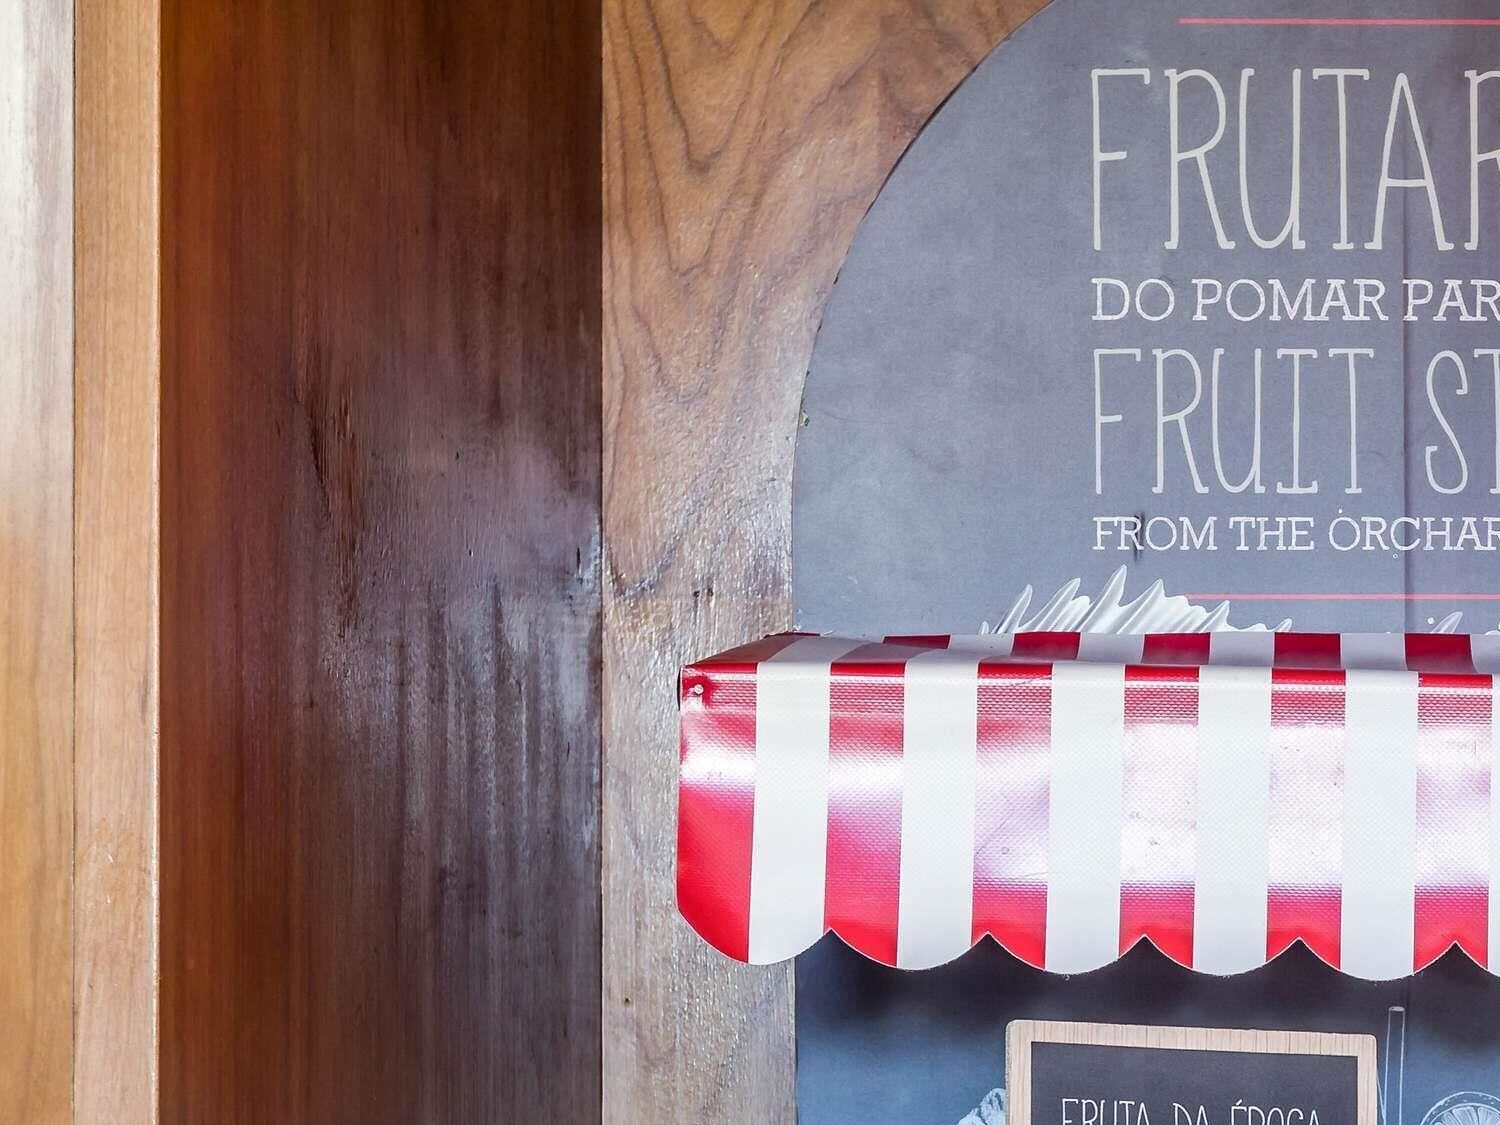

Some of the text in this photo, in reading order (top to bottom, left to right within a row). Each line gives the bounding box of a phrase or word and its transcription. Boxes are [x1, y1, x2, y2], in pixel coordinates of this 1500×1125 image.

[1092, 278, 1175, 321] DO
[1192, 278, 1388, 321] POMAR
[1094, 348, 1374, 494] FRUIT
[1092, 516, 1217, 551] FROM
[1229, 516, 1315, 551] THE
